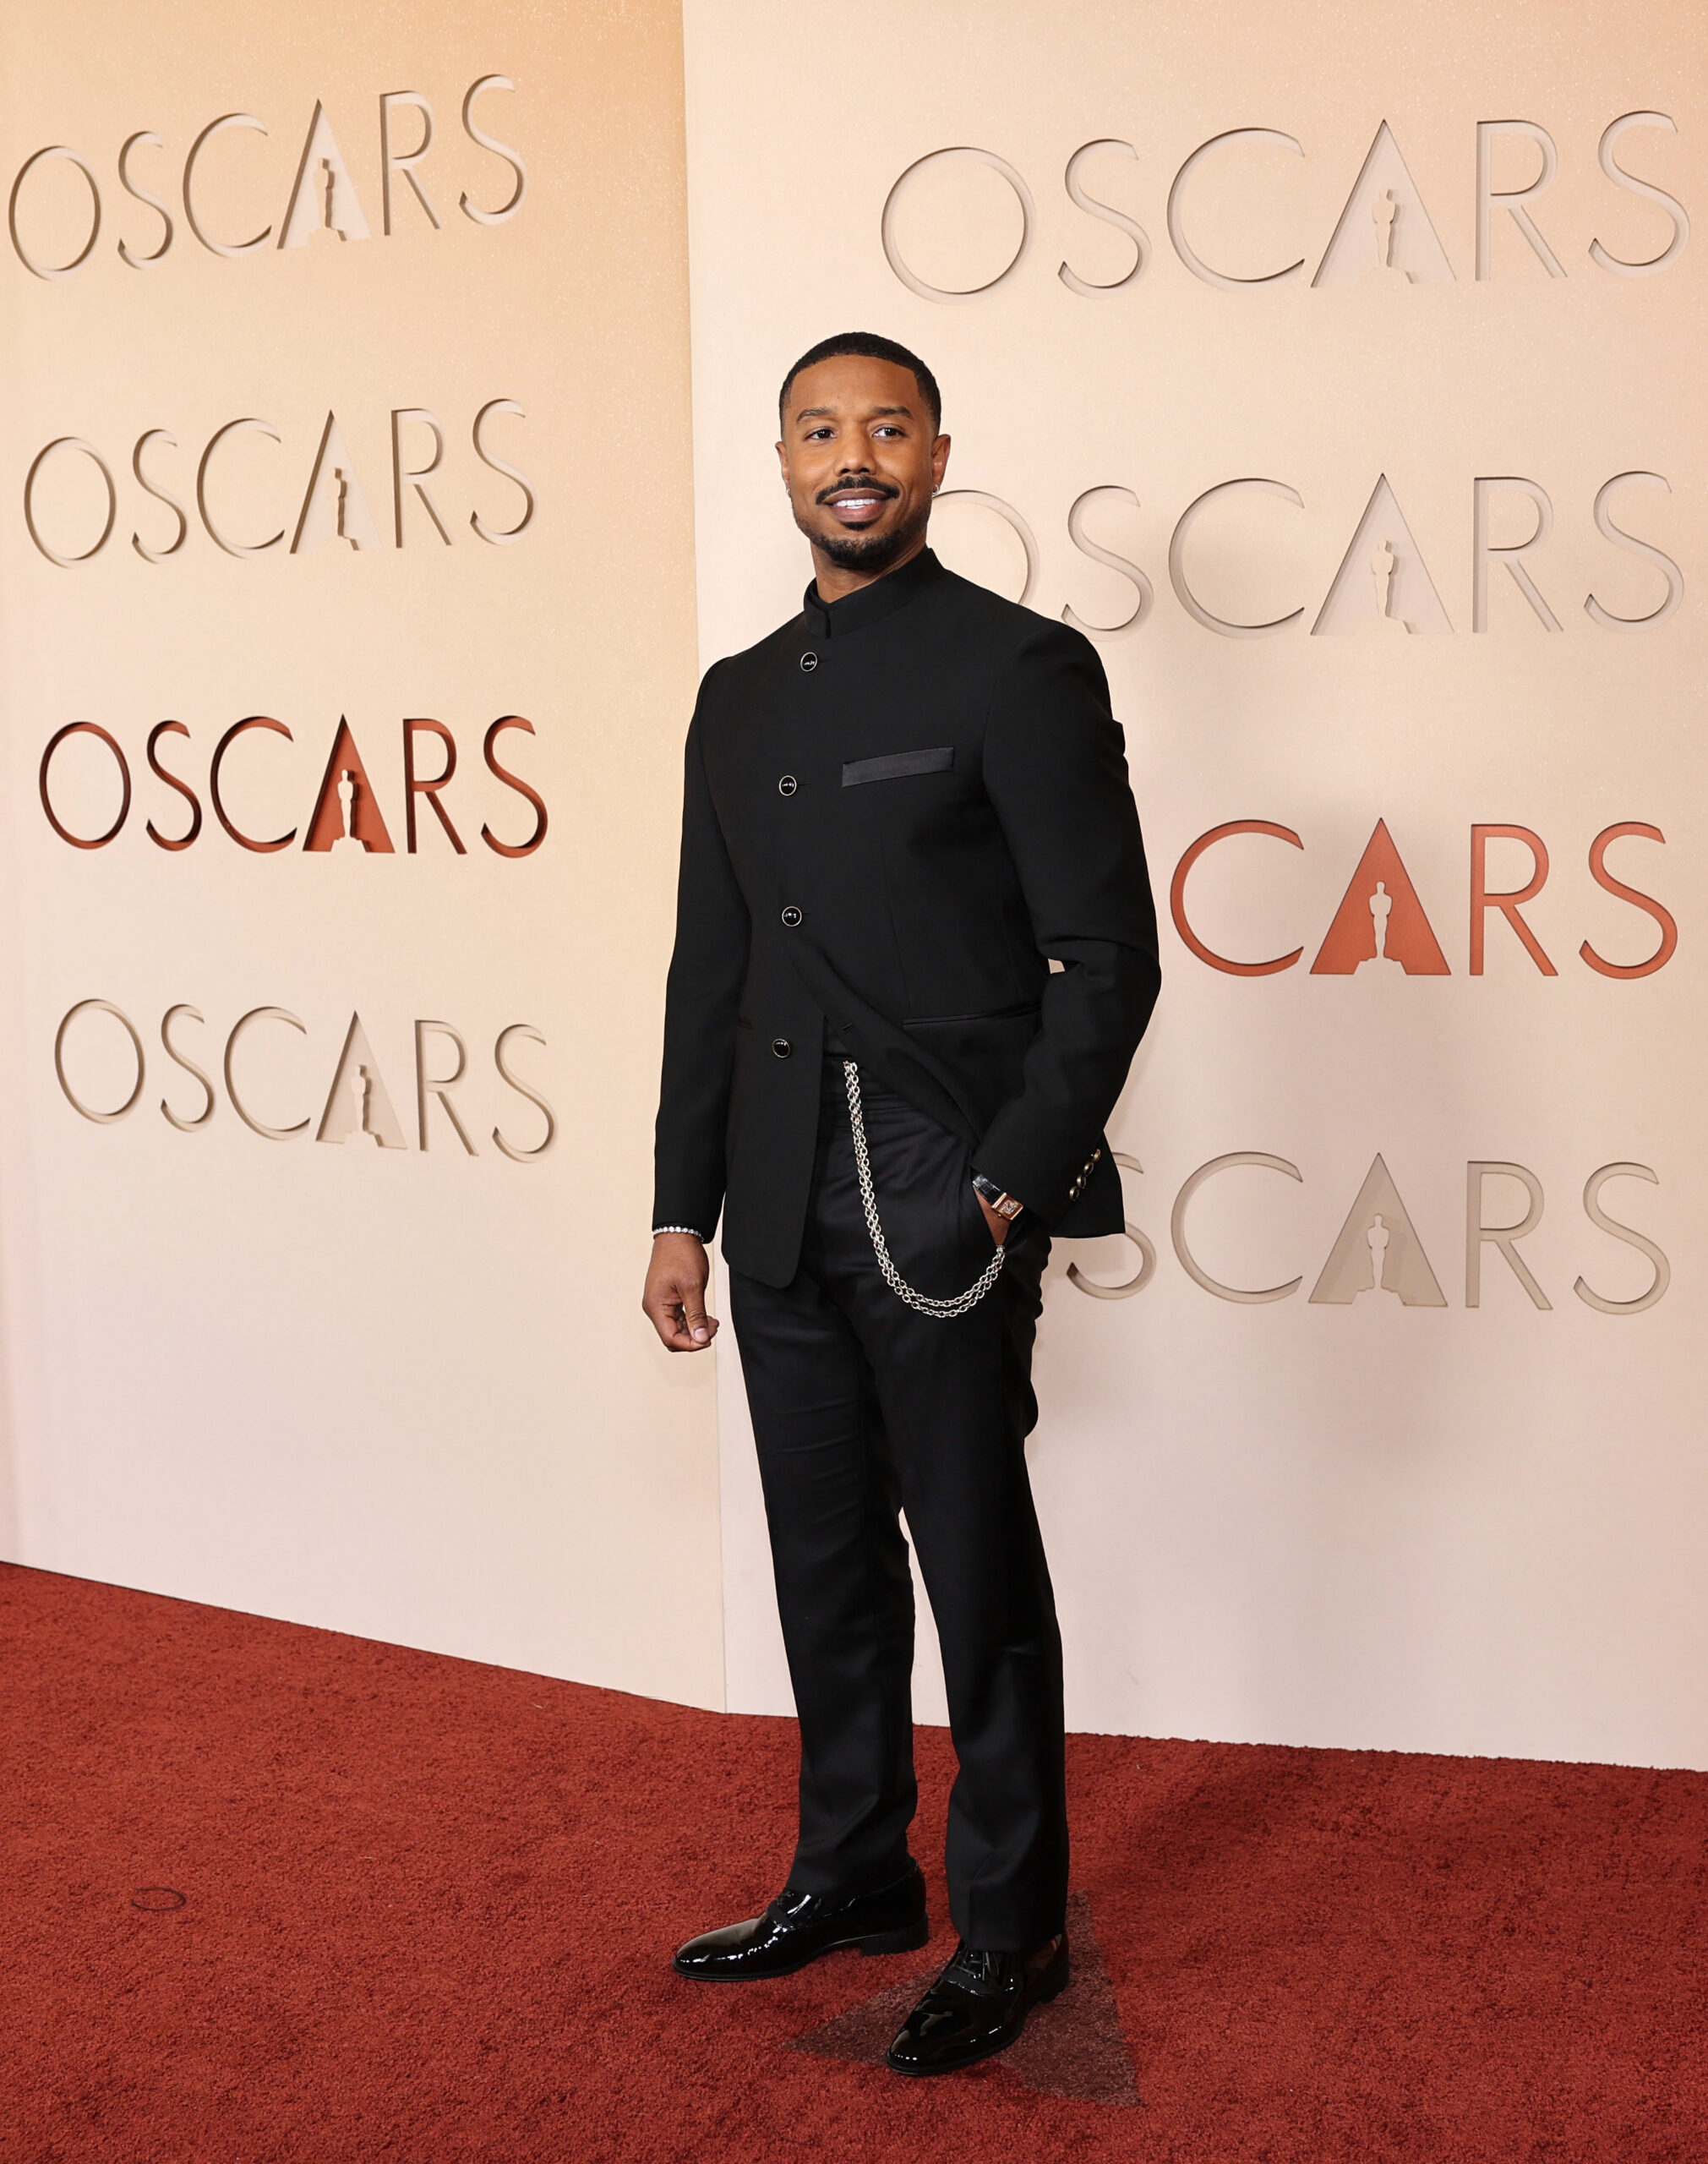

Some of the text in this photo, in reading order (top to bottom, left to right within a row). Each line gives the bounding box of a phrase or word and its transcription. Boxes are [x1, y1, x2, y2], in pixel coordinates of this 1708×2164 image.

[8, 74, 526, 281] OSCARS
[881, 110, 1689, 305] OSCARS
[24, 398, 536, 568] OSCARS
[39, 713, 548, 859] OSCARS
[54, 998, 559, 1163] OSCARS
